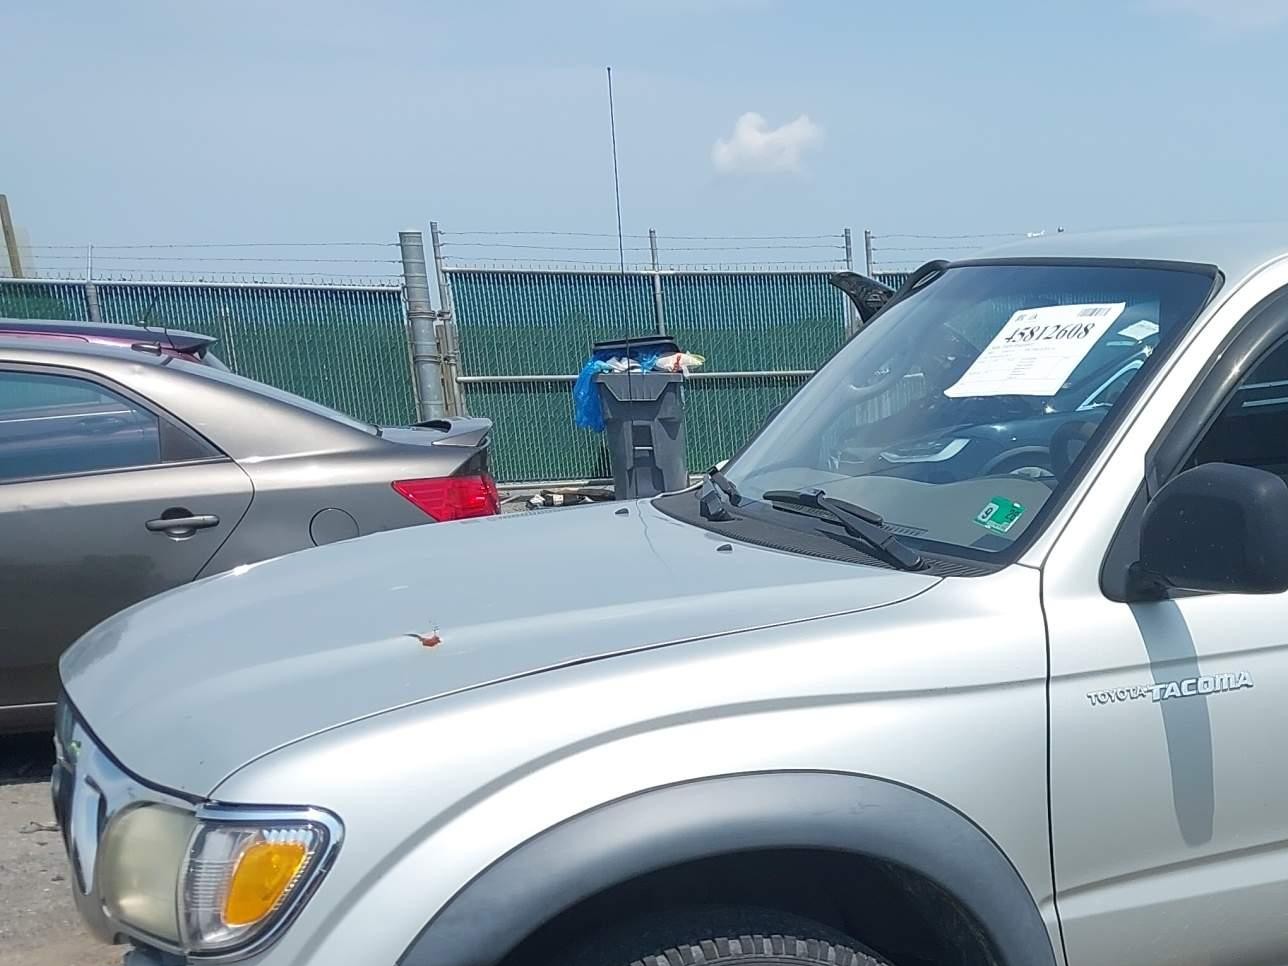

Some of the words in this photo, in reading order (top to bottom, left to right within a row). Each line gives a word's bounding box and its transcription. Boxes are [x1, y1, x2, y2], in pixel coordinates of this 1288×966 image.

[1005, 322, 1095, 343] 45812608
[1087, 685, 1147, 706] TOYOTA
[1150, 671, 1254, 703] TACOMA
